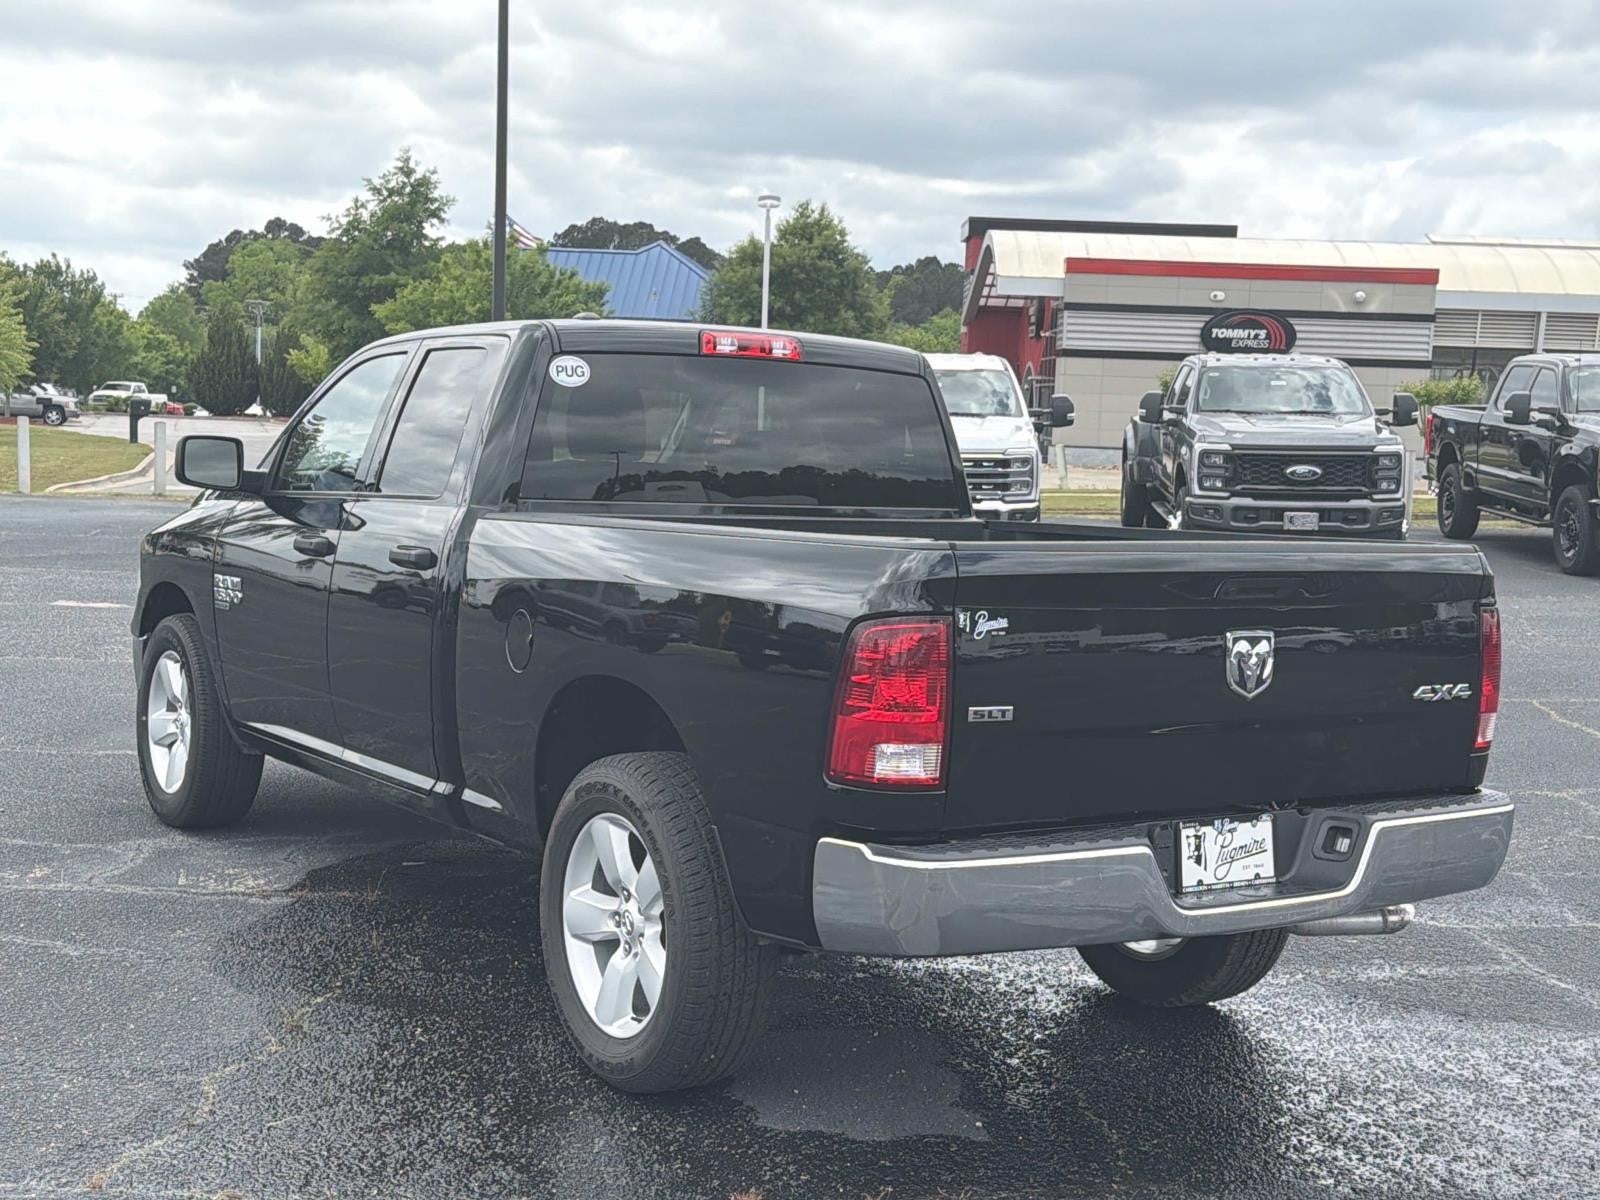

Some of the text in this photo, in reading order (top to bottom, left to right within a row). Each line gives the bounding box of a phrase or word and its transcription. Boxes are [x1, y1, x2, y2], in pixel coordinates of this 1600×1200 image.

[1211, 328, 1268, 340] TOMMY'S
[1231, 339, 1270, 349] EXPRESS
[555, 364, 586, 378] PUG
[214, 574, 241, 590] RAM
[214, 587, 243, 604] 1500
[970, 707, 1012, 720] SLT
[1213, 831, 1268, 880] Pugmire
